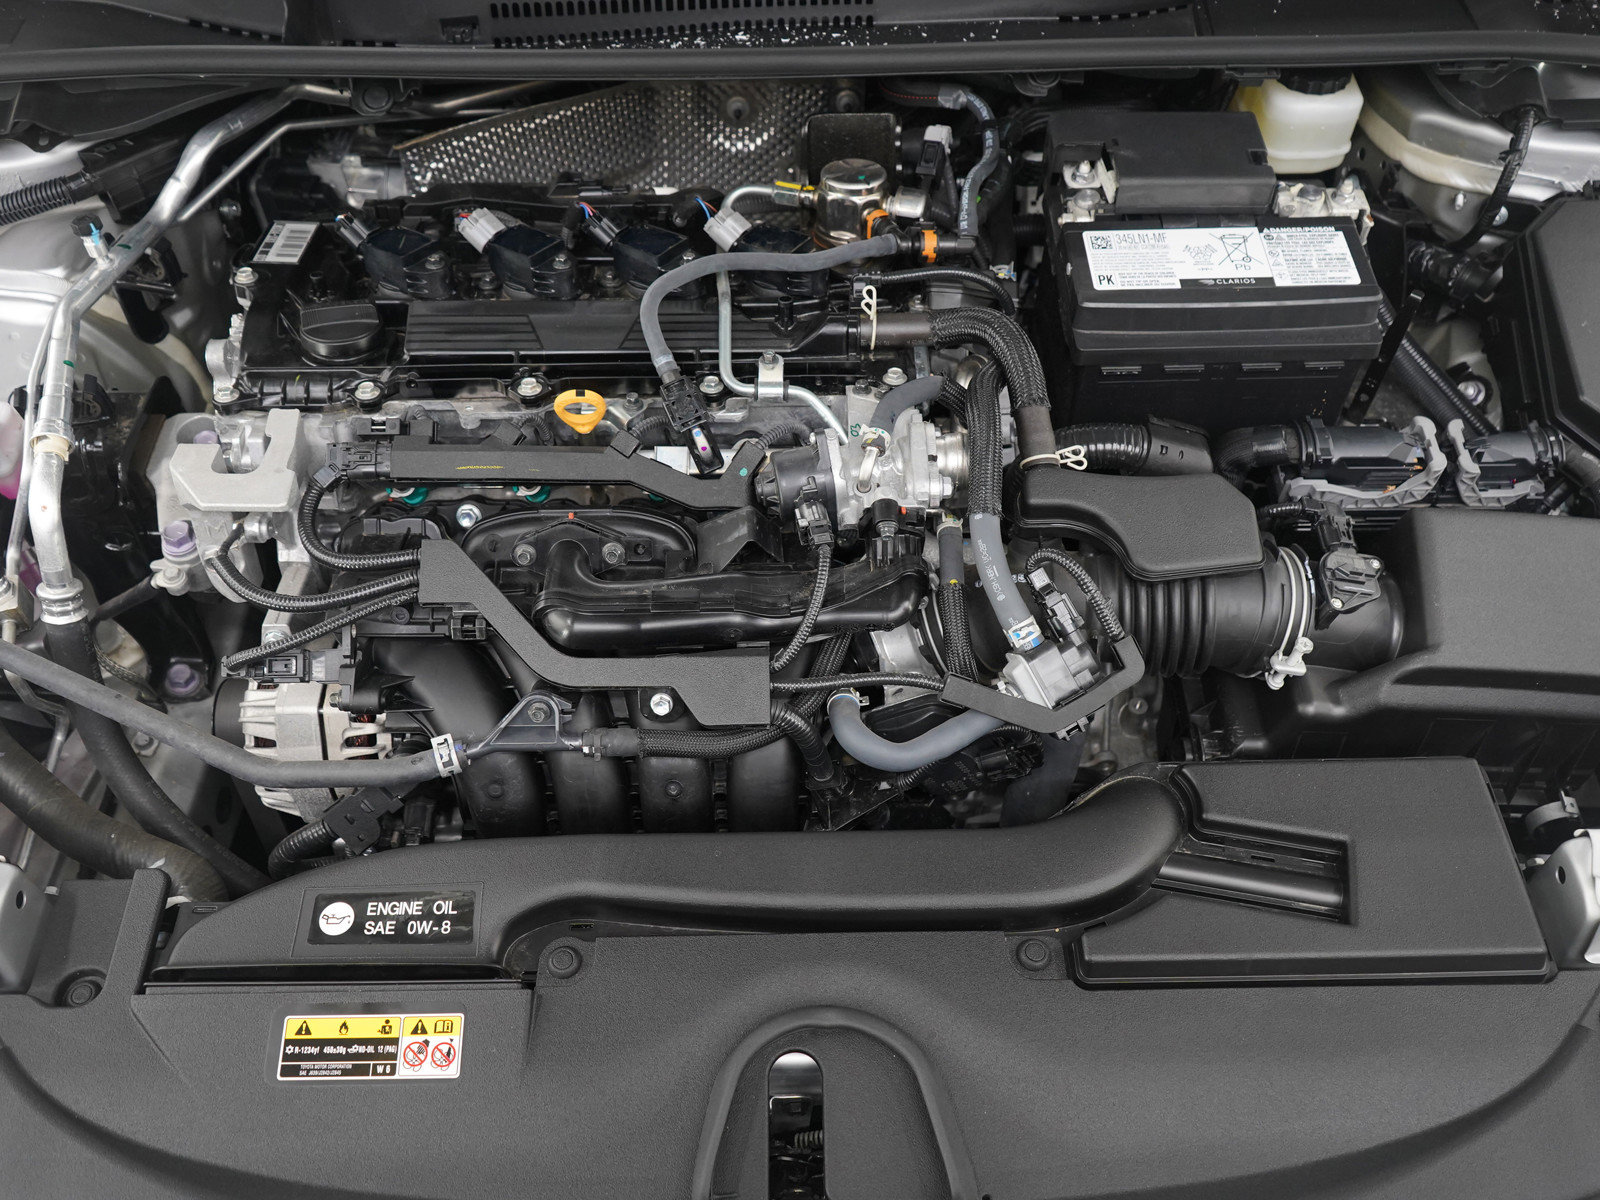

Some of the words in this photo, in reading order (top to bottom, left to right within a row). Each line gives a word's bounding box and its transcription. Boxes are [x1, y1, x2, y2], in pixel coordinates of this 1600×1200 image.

[1115, 232, 1167, 245] 345LN1-MF
[1234, 263, 1251, 271] Pb
[1097, 274, 1115, 286] PK
[366, 901, 423, 916] ENGINE
[433, 900, 458, 915] OIL
[364, 921, 396, 935] SAE
[407, 920, 451, 934] 0W-8
[377, 1045, 384, 1053] 12
[376, 1065, 384, 1073] W
